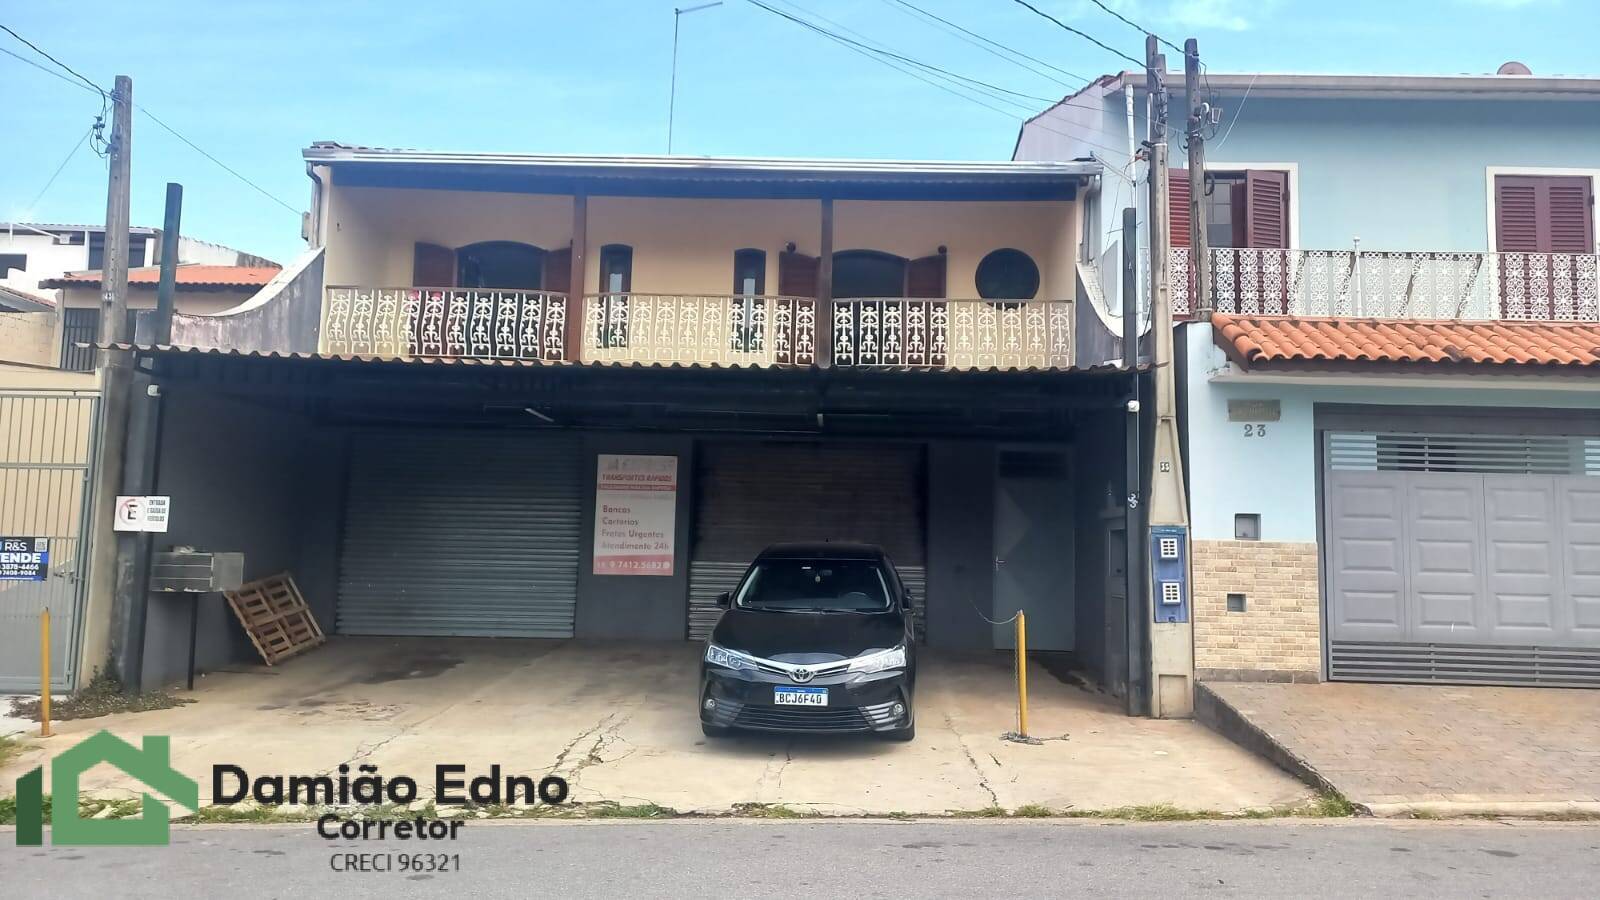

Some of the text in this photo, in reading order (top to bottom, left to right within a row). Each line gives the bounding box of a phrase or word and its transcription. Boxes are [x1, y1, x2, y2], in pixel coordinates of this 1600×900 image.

[1244, 424, 1266, 437] 23
[127, 504, 138, 520] E
[602, 504, 631, 513] Bancos
[629, 530, 664, 539] Urgentes
[4, 542, 27, 551] R&S
[653, 542, 670, 550] 24h
[0, 552, 41, 563] ENDE
[779, 693, 822, 704] BCJ6F40
